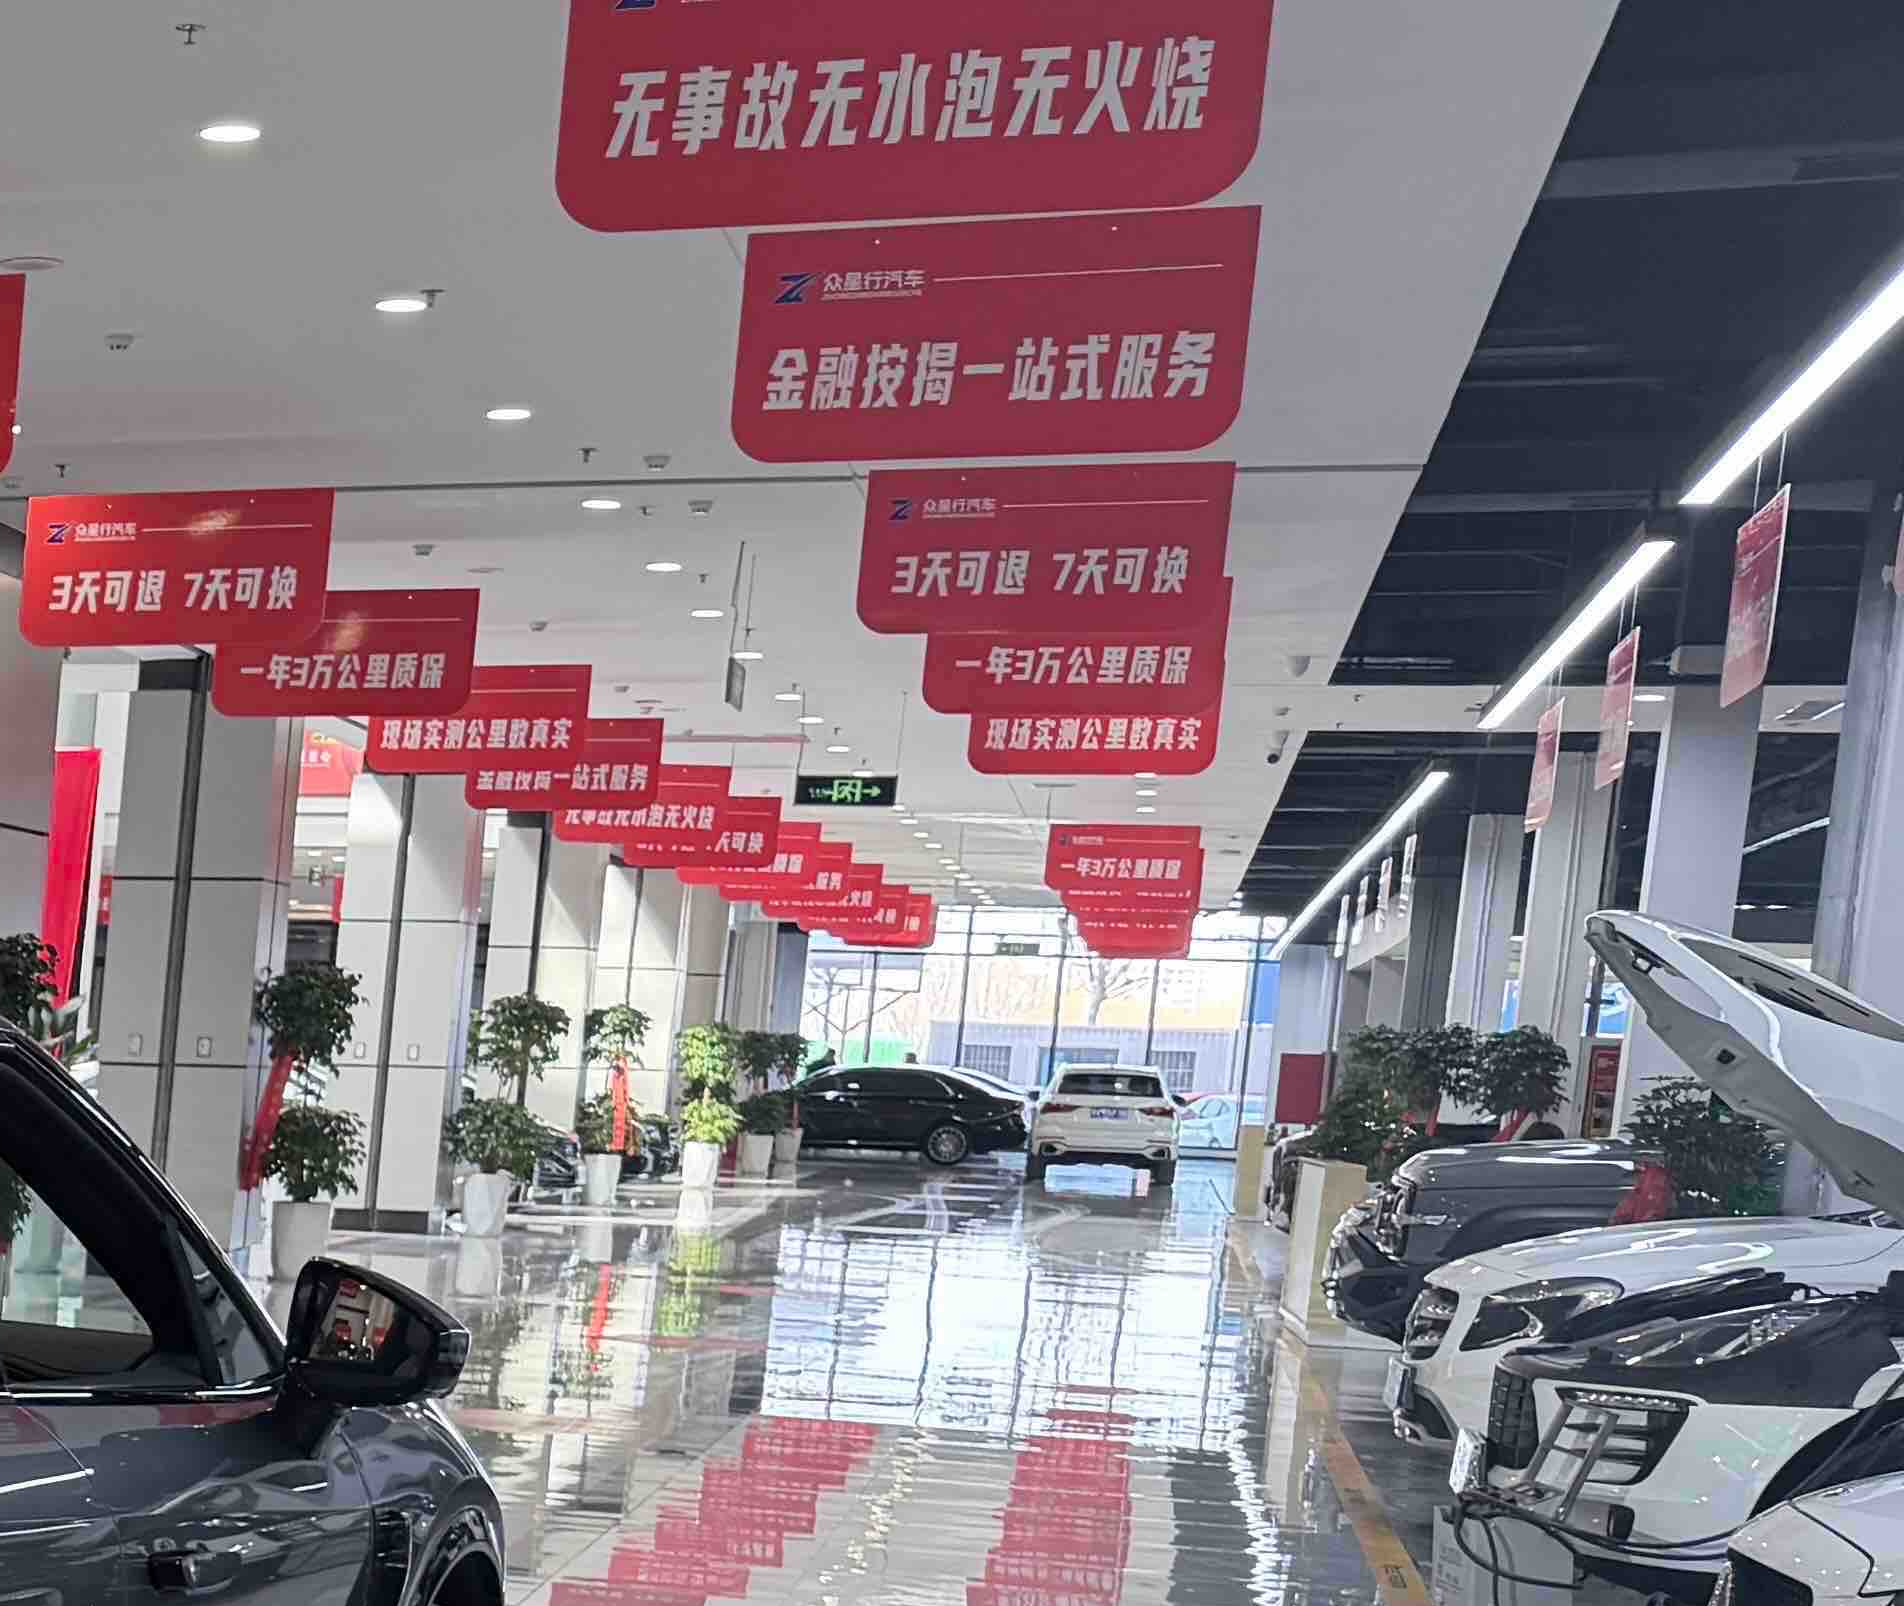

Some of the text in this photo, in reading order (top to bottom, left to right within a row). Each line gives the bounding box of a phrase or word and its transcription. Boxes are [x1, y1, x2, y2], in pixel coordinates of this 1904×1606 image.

[604, 36, 1216, 159] 无事故无水泡无火烧
[823, 269, 926, 293] 众星行汽车
[761, 330, 1217, 411] 金融按揭一站式服务
[74, 521, 137, 538] 众星行汽车
[47, 564, 298, 614] 3天可退 7天可换
[890, 546, 1190, 597] 3天可退 7天可换
[239, 651, 447, 691] 一年3万公里质保
[955, 646, 1193, 686] 一年3万公里质保
[380, 717, 573, 750] 现场实测公里数真实
[984, 716, 1203, 752] 现场实测公里数真实
